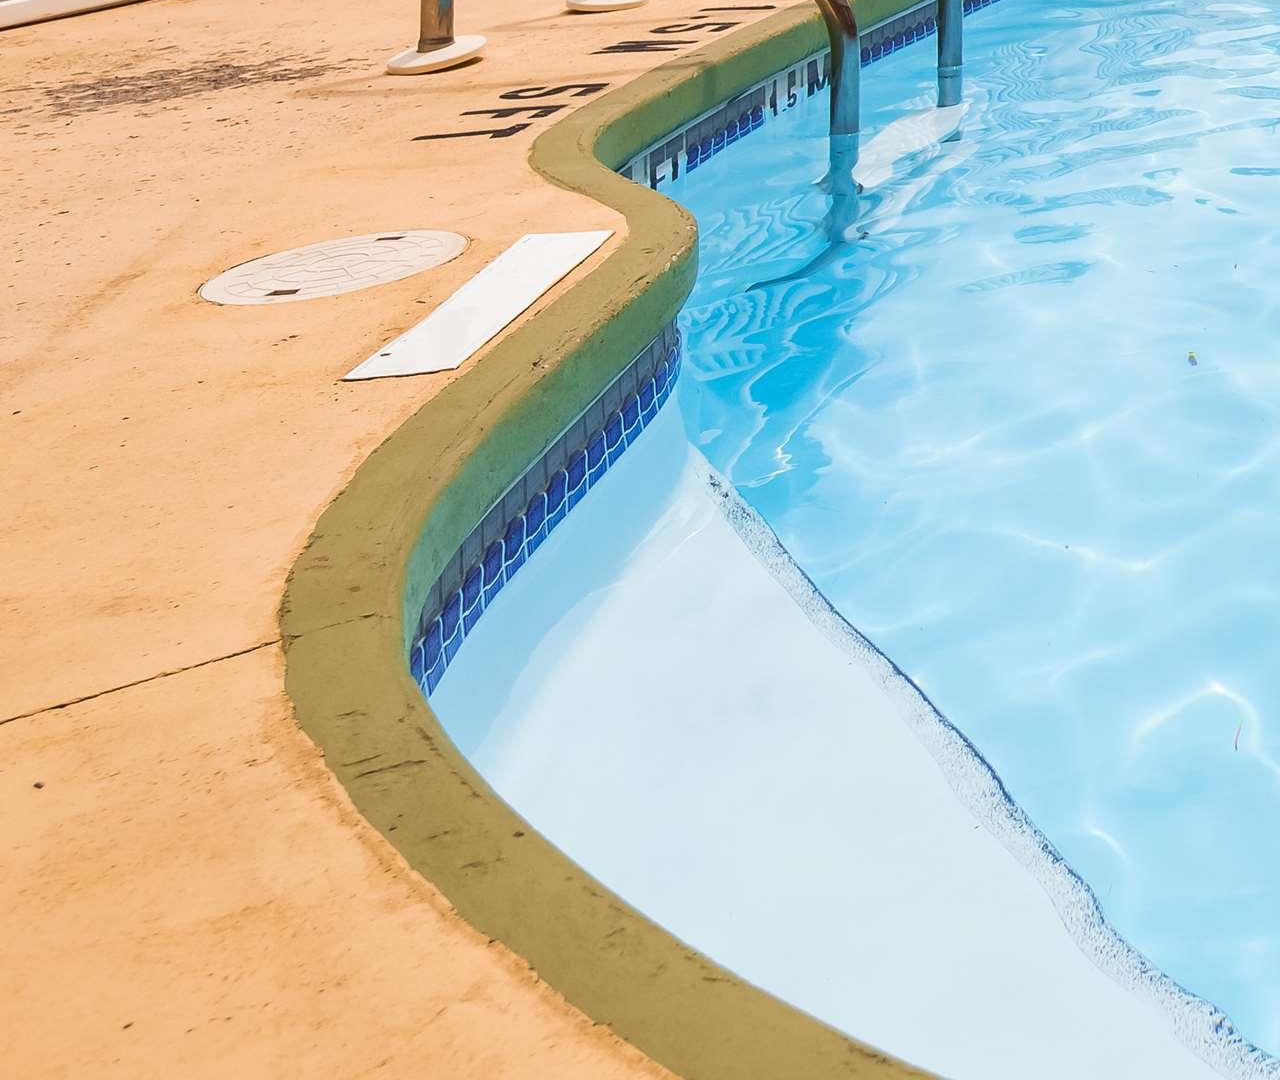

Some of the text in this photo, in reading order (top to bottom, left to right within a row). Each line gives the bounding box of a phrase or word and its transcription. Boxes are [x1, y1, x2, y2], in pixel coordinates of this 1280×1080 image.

[411, 82, 610, 142] 5 FT
[769, 70, 797, 117] 1.5
